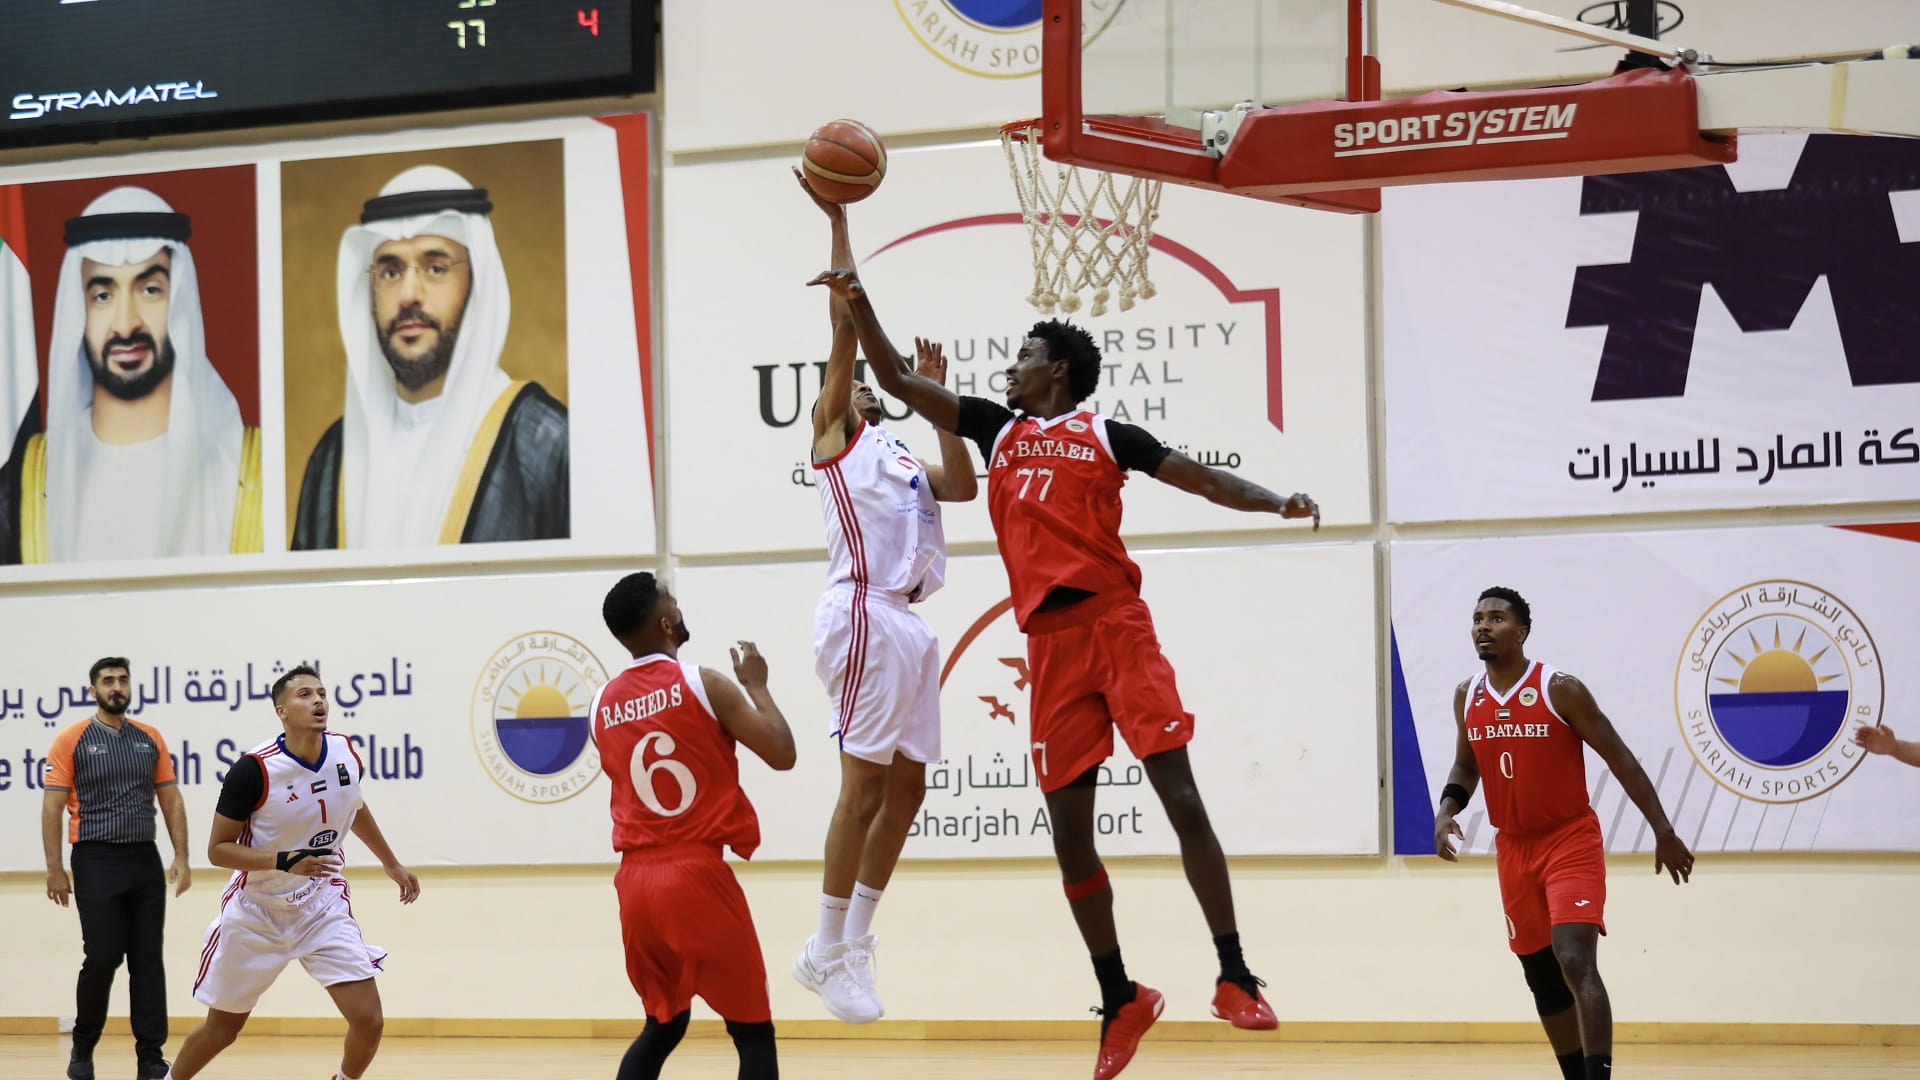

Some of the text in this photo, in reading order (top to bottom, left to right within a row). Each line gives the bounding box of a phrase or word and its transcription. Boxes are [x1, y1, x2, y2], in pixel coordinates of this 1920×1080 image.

[447, 19, 486, 48] 77
[577, 9, 598, 36] 4
[1334, 103, 1578, 148] SPORT SYSTEM
[1015, 439, 1096, 462] BATAEH
[1568, 437, 1721, 493] للسيارات
[1736, 431, 1842, 485] المارد
[1016, 467, 1054, 502] 77
[1691, 586, 1873, 673] نادي الشارقة الرياضي
[334, 657, 413, 718] نادي
[601, 683, 683, 730] RASHED.S
[1467, 723, 1550, 741] AL BATAEH
[1687, 709, 1752, 790] SHARJAH
[1761, 760, 1840, 796] SPORTS
[479, 730, 587, 797] SHARJAH SPORTS
[630, 730, 697, 817] 6
[1499, 752, 1514, 779] 0
[317, 798, 327, 824] 1
